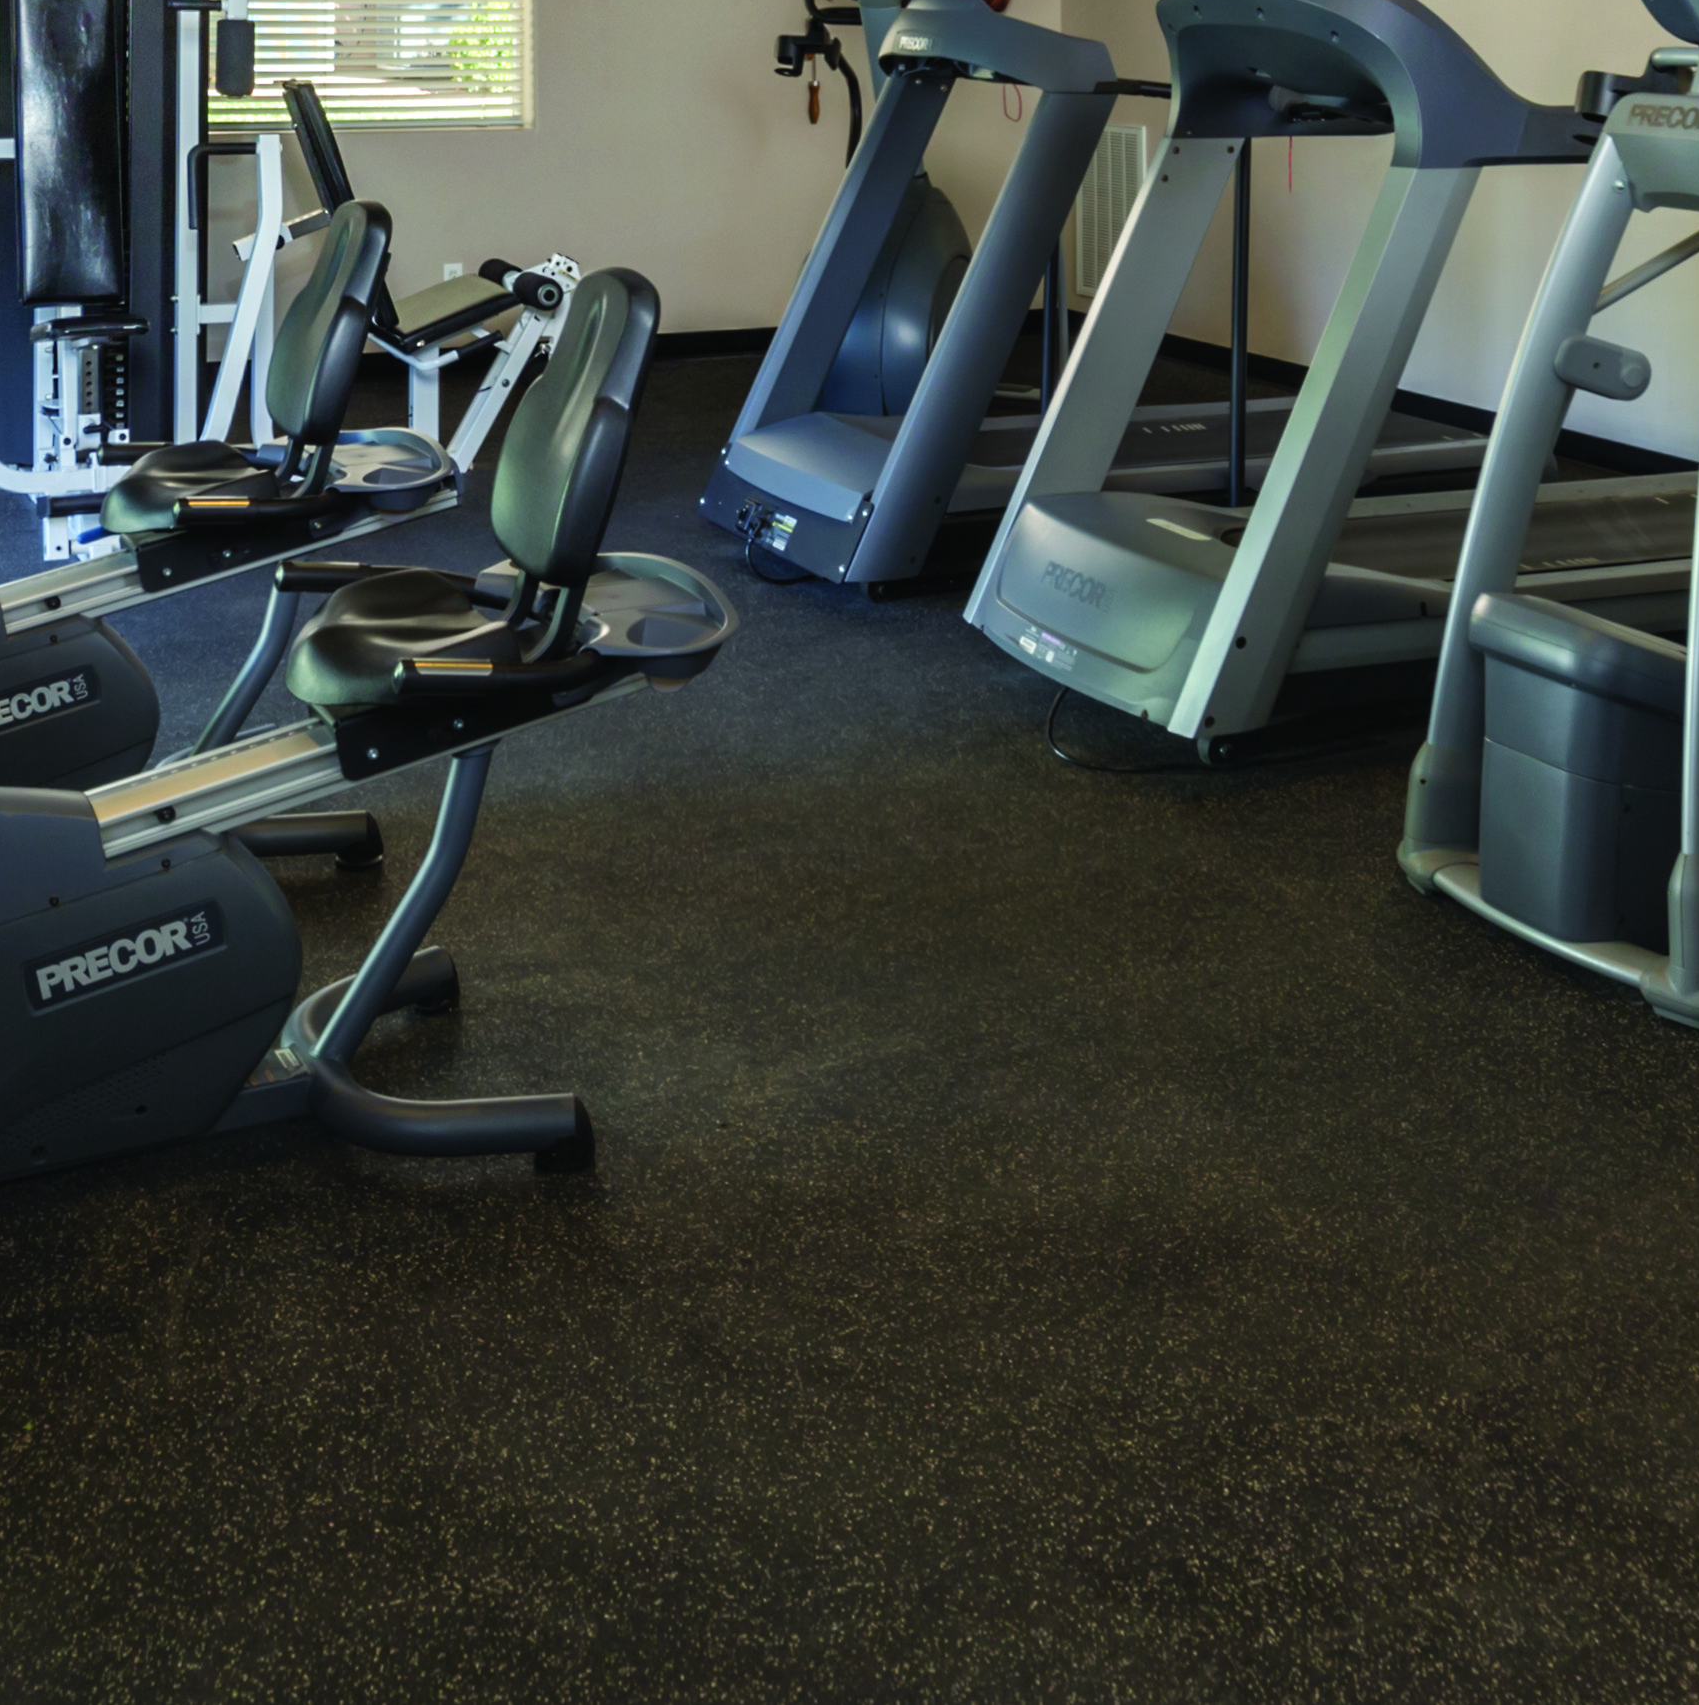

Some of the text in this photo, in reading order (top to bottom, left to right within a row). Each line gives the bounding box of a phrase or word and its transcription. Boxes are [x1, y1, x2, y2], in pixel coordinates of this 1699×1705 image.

[74, 673, 88, 700] USA
[35, 911, 211, 1000] PRECOR USA
